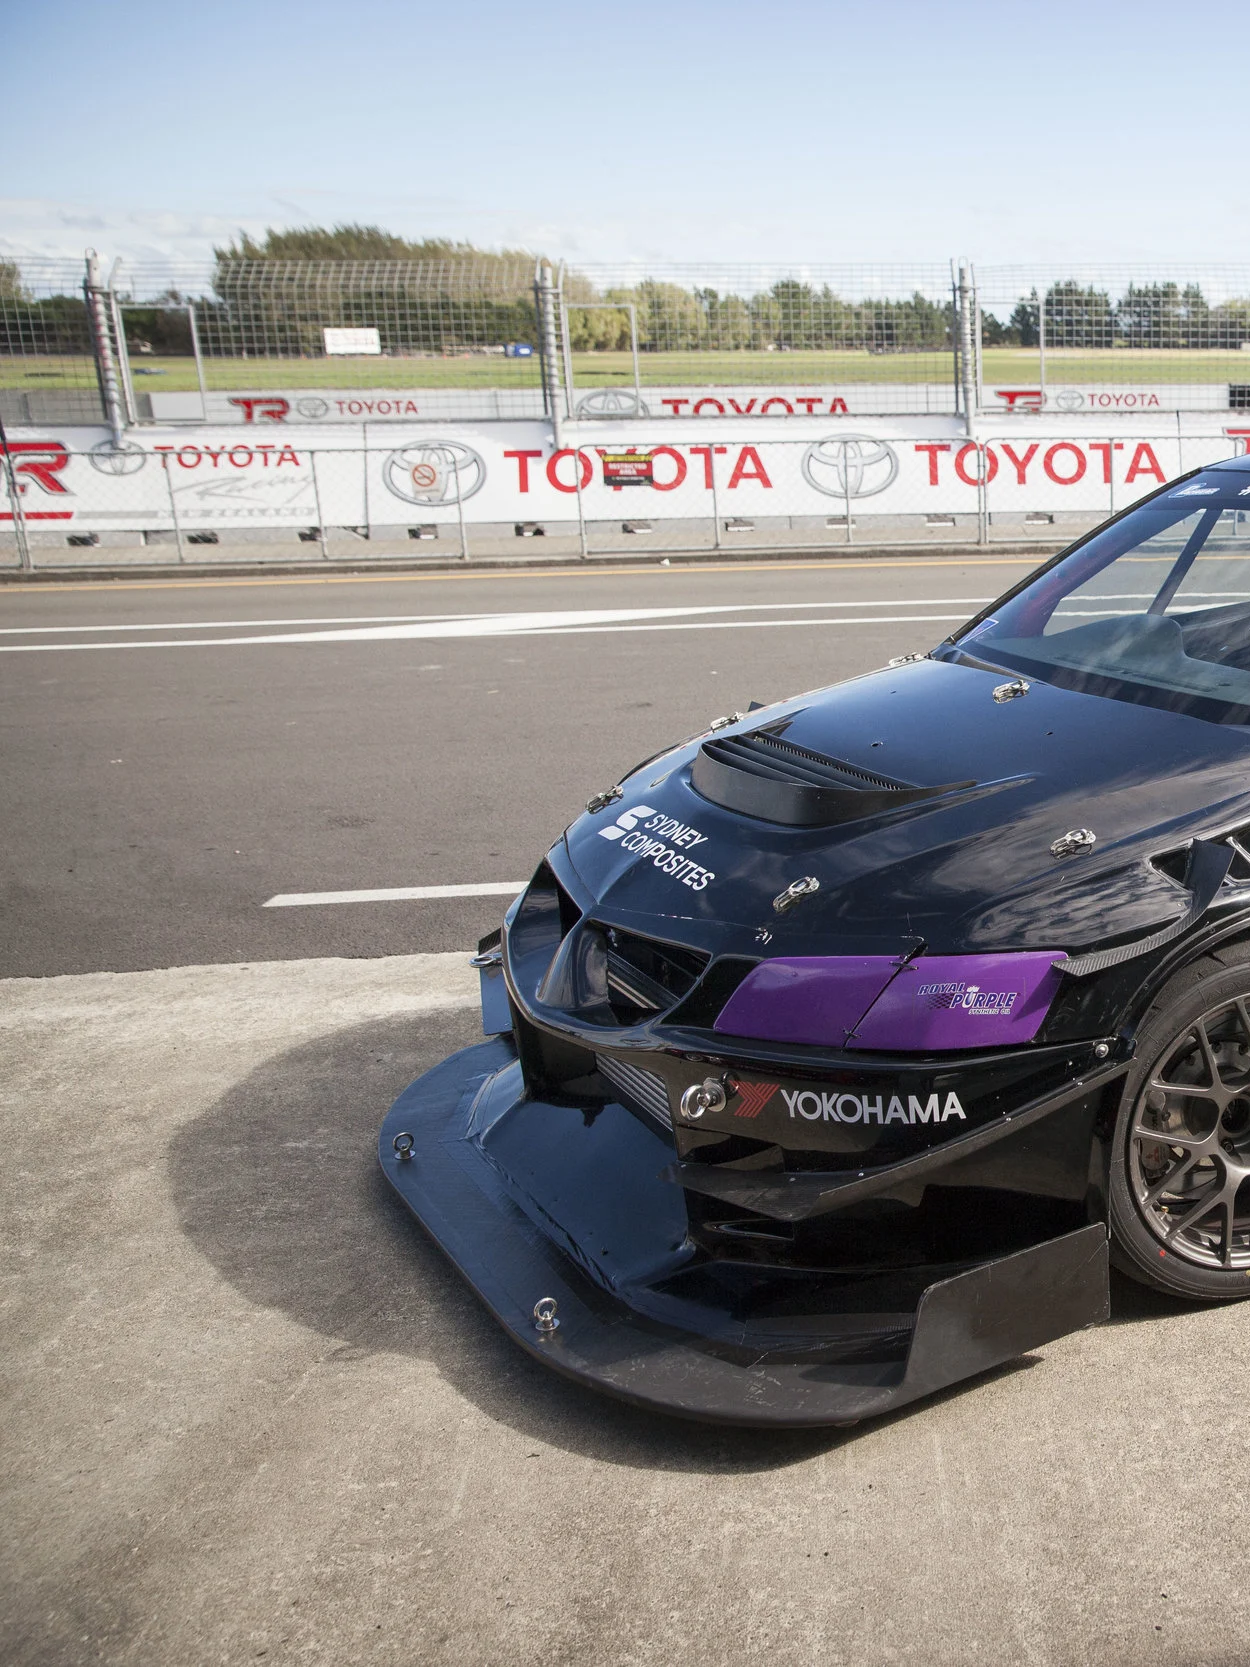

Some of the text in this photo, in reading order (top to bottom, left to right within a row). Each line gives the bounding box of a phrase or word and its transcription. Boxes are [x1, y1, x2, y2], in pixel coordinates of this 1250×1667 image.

[335, 400, 419, 416] TOYOTA
[1087, 393, 1160, 408] TOYOTA
[153, 444, 301, 469] TOYOTA
[914, 442, 1167, 487] TOYOTA
[644, 814, 709, 850] SYDNEY
[620, 831, 716, 891] COMPOSITES
[918, 982, 966, 996] ROYAL
[949, 992, 1018, 1009] PURPLE
[780, 1091, 967, 1125] YOKOHAMA
